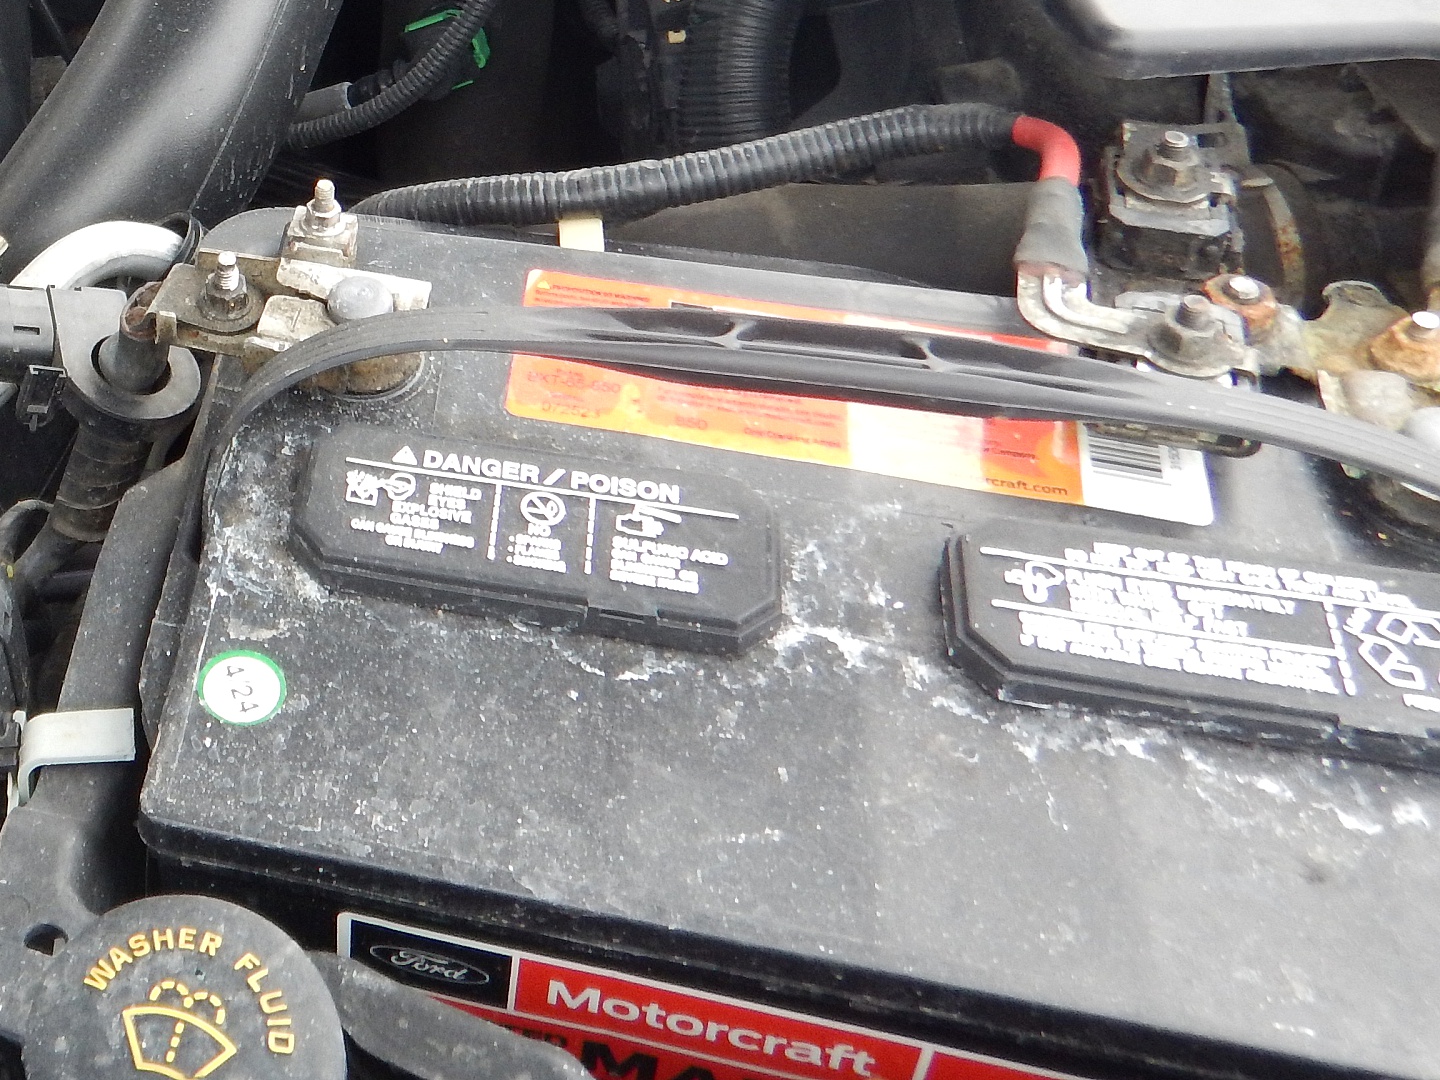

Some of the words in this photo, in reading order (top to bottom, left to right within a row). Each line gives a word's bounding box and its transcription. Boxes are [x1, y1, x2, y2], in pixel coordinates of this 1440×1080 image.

[422, 449, 540, 483] DANGER
[569, 470, 680, 504] POISON
[391, 500, 473, 524] EXPLOSIVE
[690, 549, 729, 566] ACID
[83, 926, 223, 992] WASHER
[233, 952, 295, 1054] FLUID
[390, 950, 468, 981] Ford
[546, 978, 877, 1077] Motorcraft
